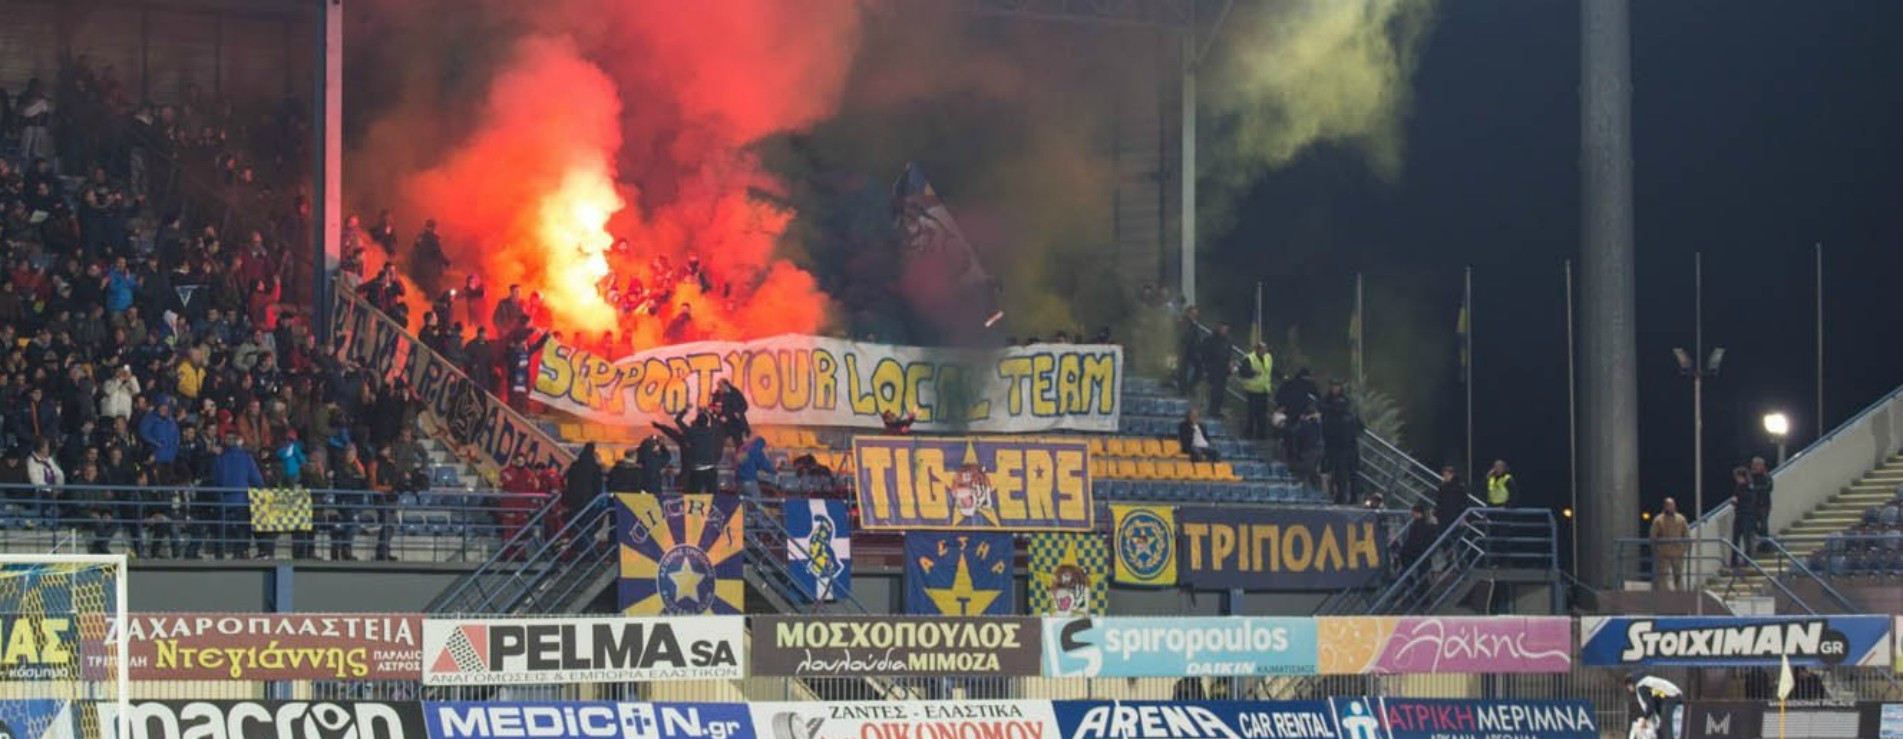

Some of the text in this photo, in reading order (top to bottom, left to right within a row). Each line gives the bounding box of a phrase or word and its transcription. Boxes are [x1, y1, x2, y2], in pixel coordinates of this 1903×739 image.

[724, 348, 838, 410] YOUR
[998, 352, 1116, 416] TEAM
[861, 446, 1086, 521] TIGERS
[1183, 523, 1380, 572] ΤΡΙΠΟΛΗ
[0, 618, 69, 663] ΑΣ
[104, 616, 414, 646] ΖΑΧΑΡΟΠΛΑΣΤΕΙΑ
[776, 622, 1021, 648] ΜΟΣΧΟΠΟΥΛΟΣ
[1105, 620, 1288, 661] spiropoulos
[87, 655, 147, 668] ΤΡΙΠΛΗ
[154, 639, 369, 679] Ντεγιάννης
[489, 623, 737, 671] PELMA SA
[908, 653, 1000, 671] ΜΙΜΟΖΑ
[1820, 641, 1844, 655] GR
[569, 669, 643, 682] ΕΜΠΟΡΙΑ
[1185, 662, 1257, 675] DAIKIN
[828, 705, 908, 719] ΖΑΝΤΕΣ
[924, 704, 1023, 718] ΕΛΑΣΤΙΚΑ
[1072, 705, 1335, 739] ARENA CAR RENTAL
[1378, 704, 1596, 731] ΙΑΤΡΙΚΗ ΜΕΡΙΜΝΑ
